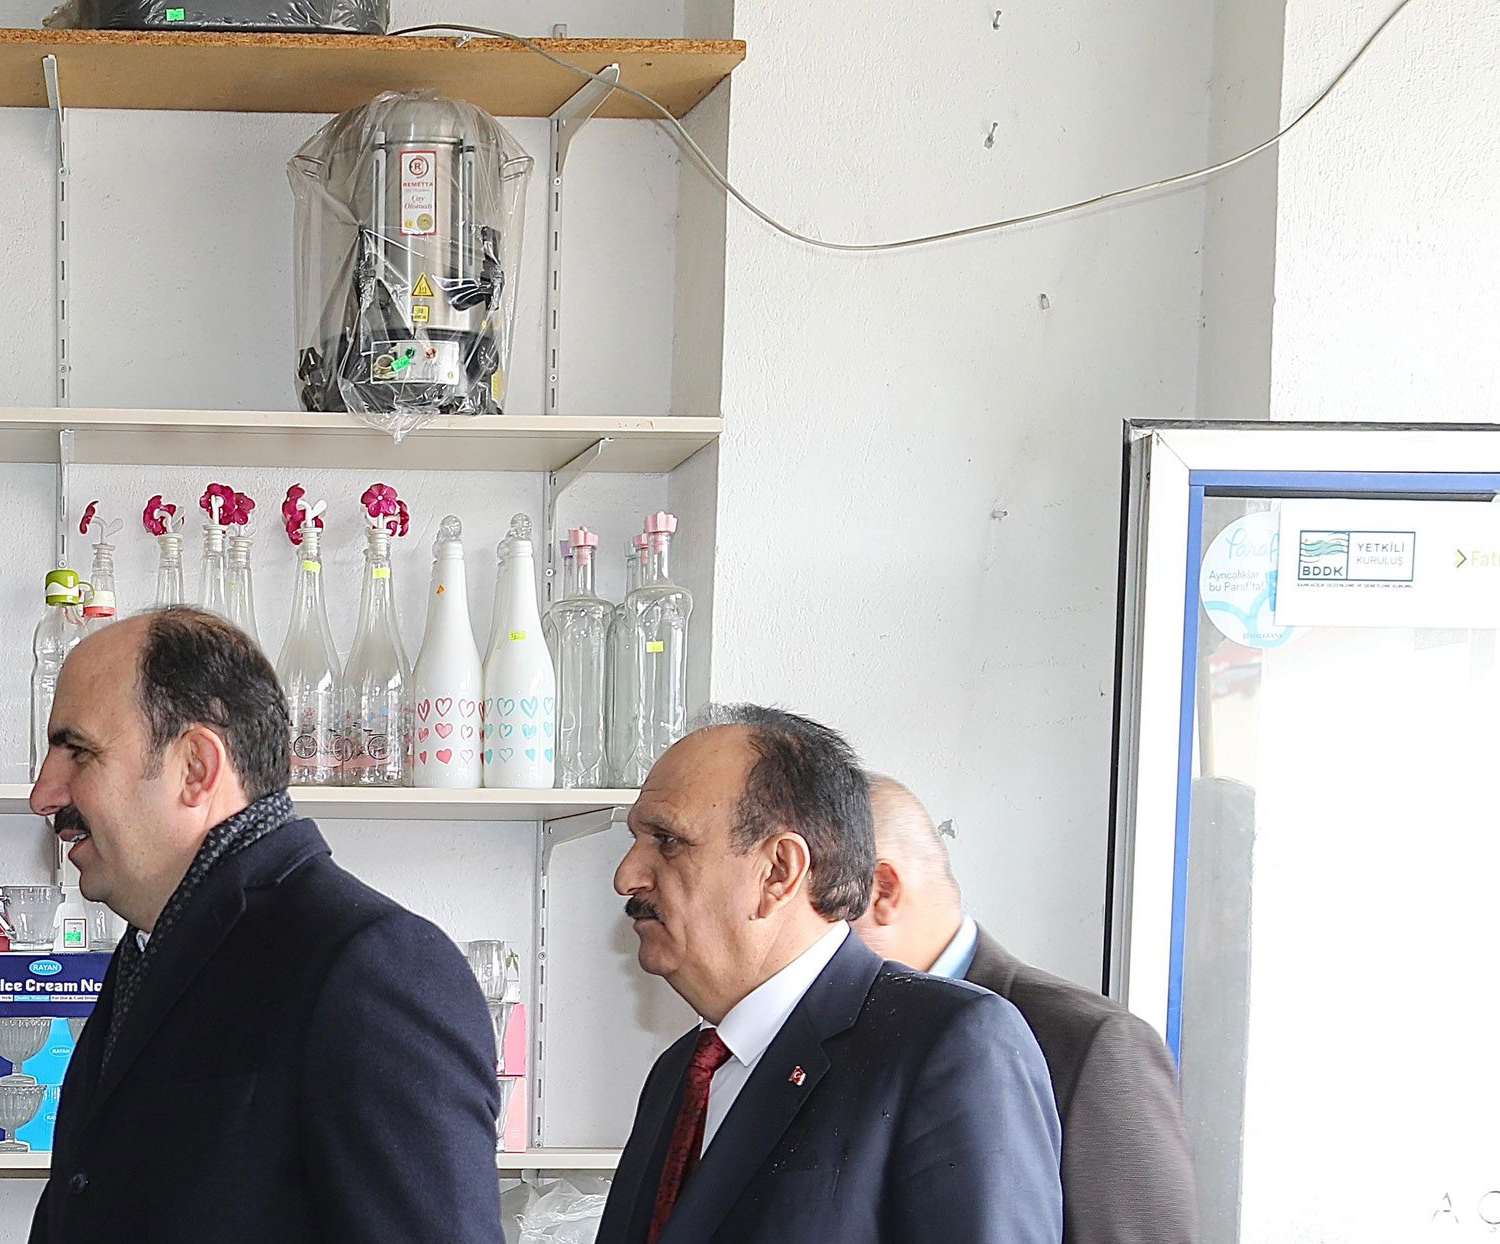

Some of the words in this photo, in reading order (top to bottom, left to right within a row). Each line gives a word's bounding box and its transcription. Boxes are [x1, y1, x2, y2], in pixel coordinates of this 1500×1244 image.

[1357, 542, 1405, 553] YETKİLİ
[1356, 556, 1404, 566] KURULUŞ
[1302, 565, 1343, 577] BDDK
[1208, 581, 1221, 592] bu
[0, 978, 23, 992] Ice
[25, 978, 78, 992] Cream
